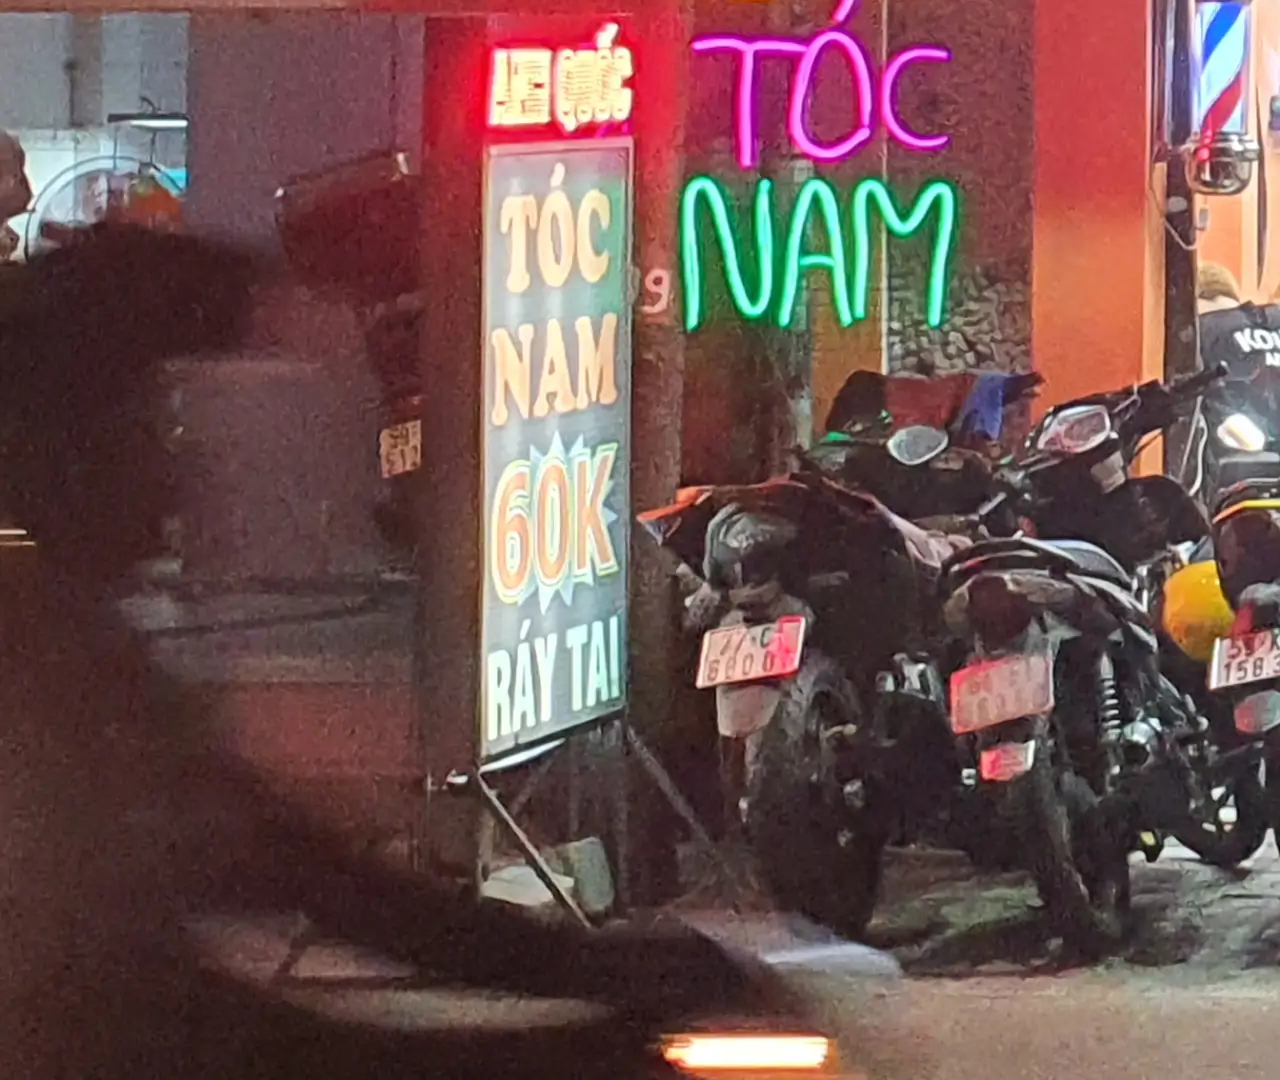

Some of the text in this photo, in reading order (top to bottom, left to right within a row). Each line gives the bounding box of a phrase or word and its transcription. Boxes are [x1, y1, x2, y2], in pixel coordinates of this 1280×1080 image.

[500, 163, 610, 293] TÓC
[681, 176, 956, 331] NAM
[490, 313, 618, 427] NAM
[490, 441, 620, 604] 60K
[486, 615, 621, 742] RÁY TAI
